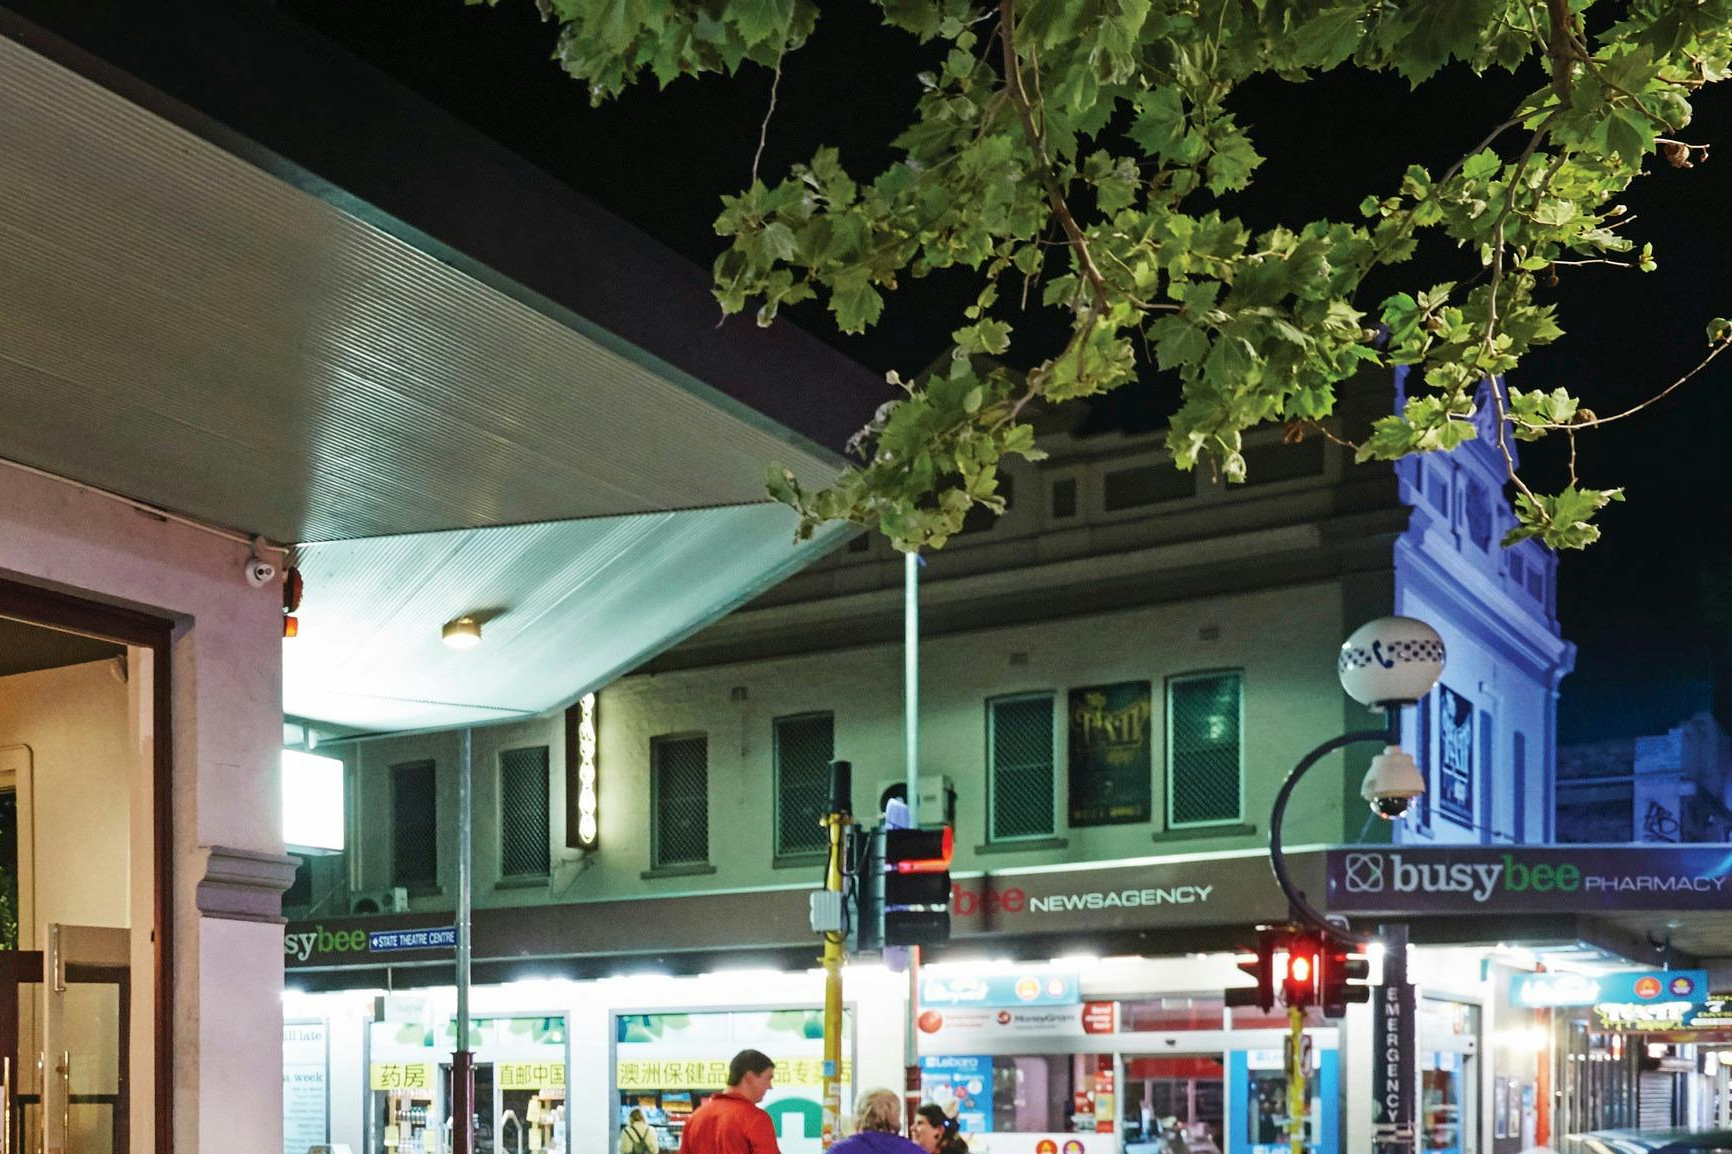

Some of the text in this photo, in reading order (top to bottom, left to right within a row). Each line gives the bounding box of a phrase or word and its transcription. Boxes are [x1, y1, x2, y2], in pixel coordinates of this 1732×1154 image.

[1391, 854, 1726, 901] busybee PHARMACY
[1030, 885, 1213, 913] NEWSAGENCY
[378, 931, 455, 948] STATE THEATRE CENTRE
[1385, 987, 1400, 1122] EMERGENCY
[381, 1063, 426, 1088] 药房
[500, 1063, 565, 1086] 直邮中国
